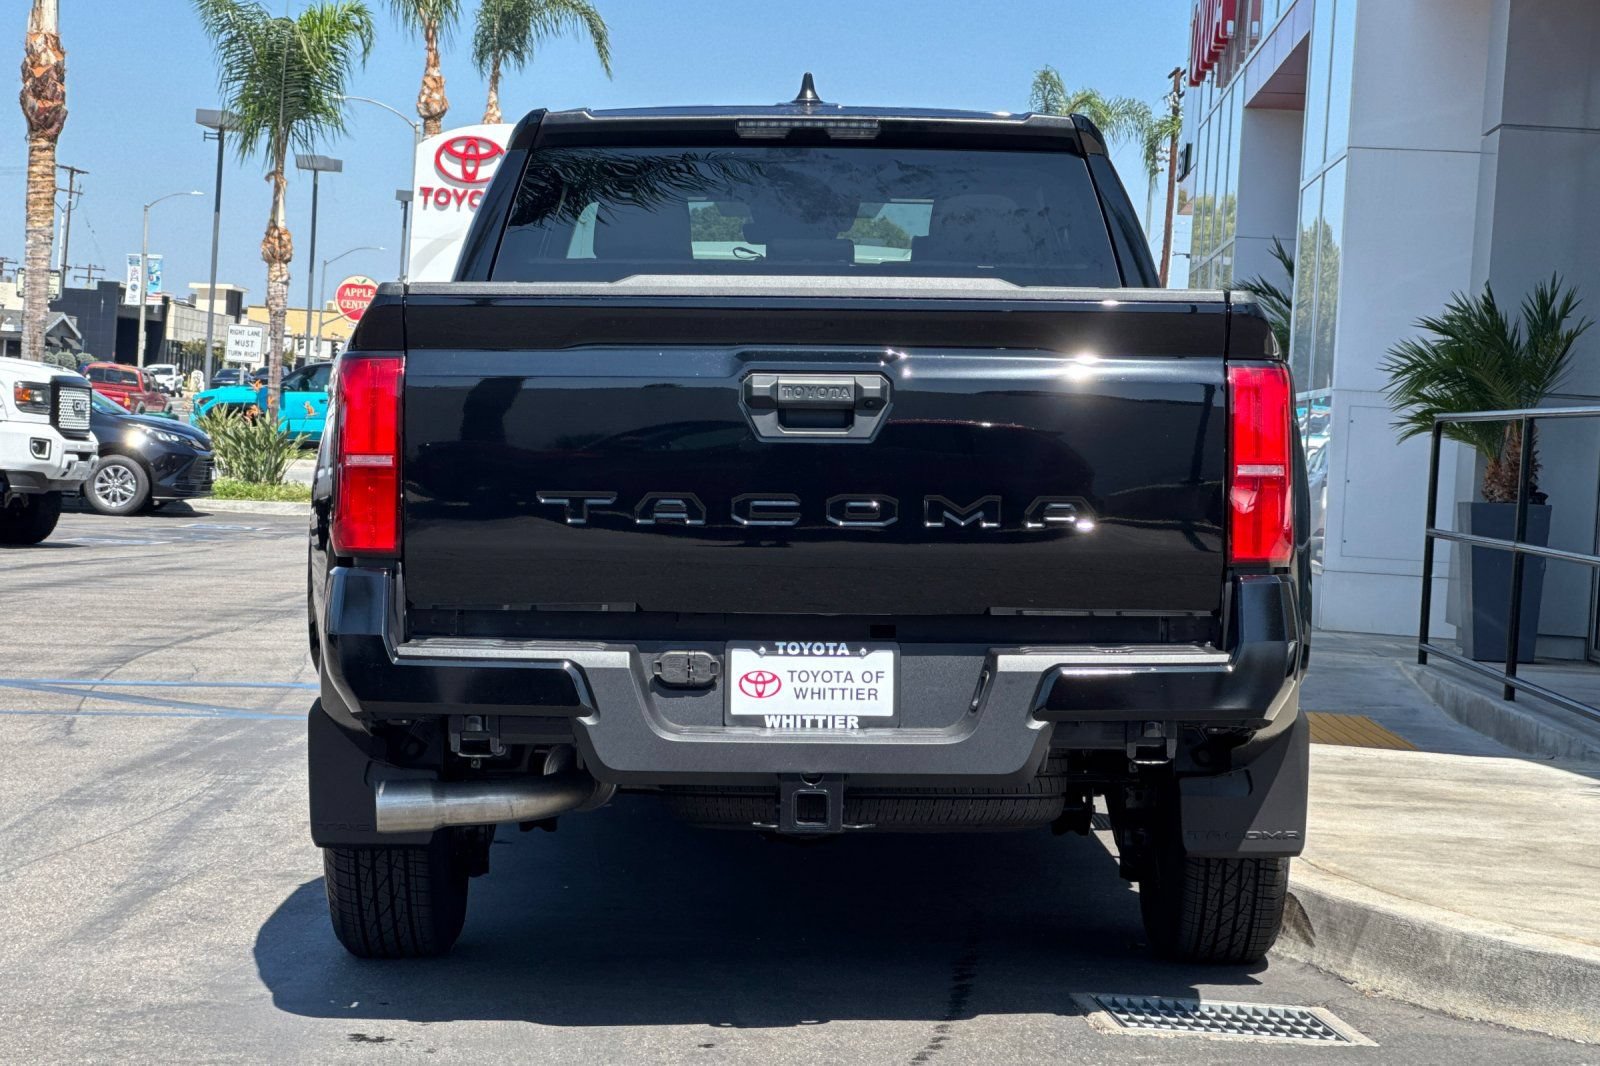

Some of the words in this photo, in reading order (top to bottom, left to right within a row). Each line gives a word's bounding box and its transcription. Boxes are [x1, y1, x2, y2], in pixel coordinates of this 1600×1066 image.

[343, 287, 374, 297] APPLE
[230, 328, 245, 336] RIGHT
[235, 339, 254, 348] MUST
[781, 386, 851, 399] TOYOTA
[536, 490, 1096, 530] TACOMA
[775, 641, 850, 656] TOYOTA
[787, 670, 854, 683] TOYOTA
[861, 670, 885, 683] OF
[794, 688, 878, 701] WHITTIER
[764, 715, 859, 729] WHITTIER
